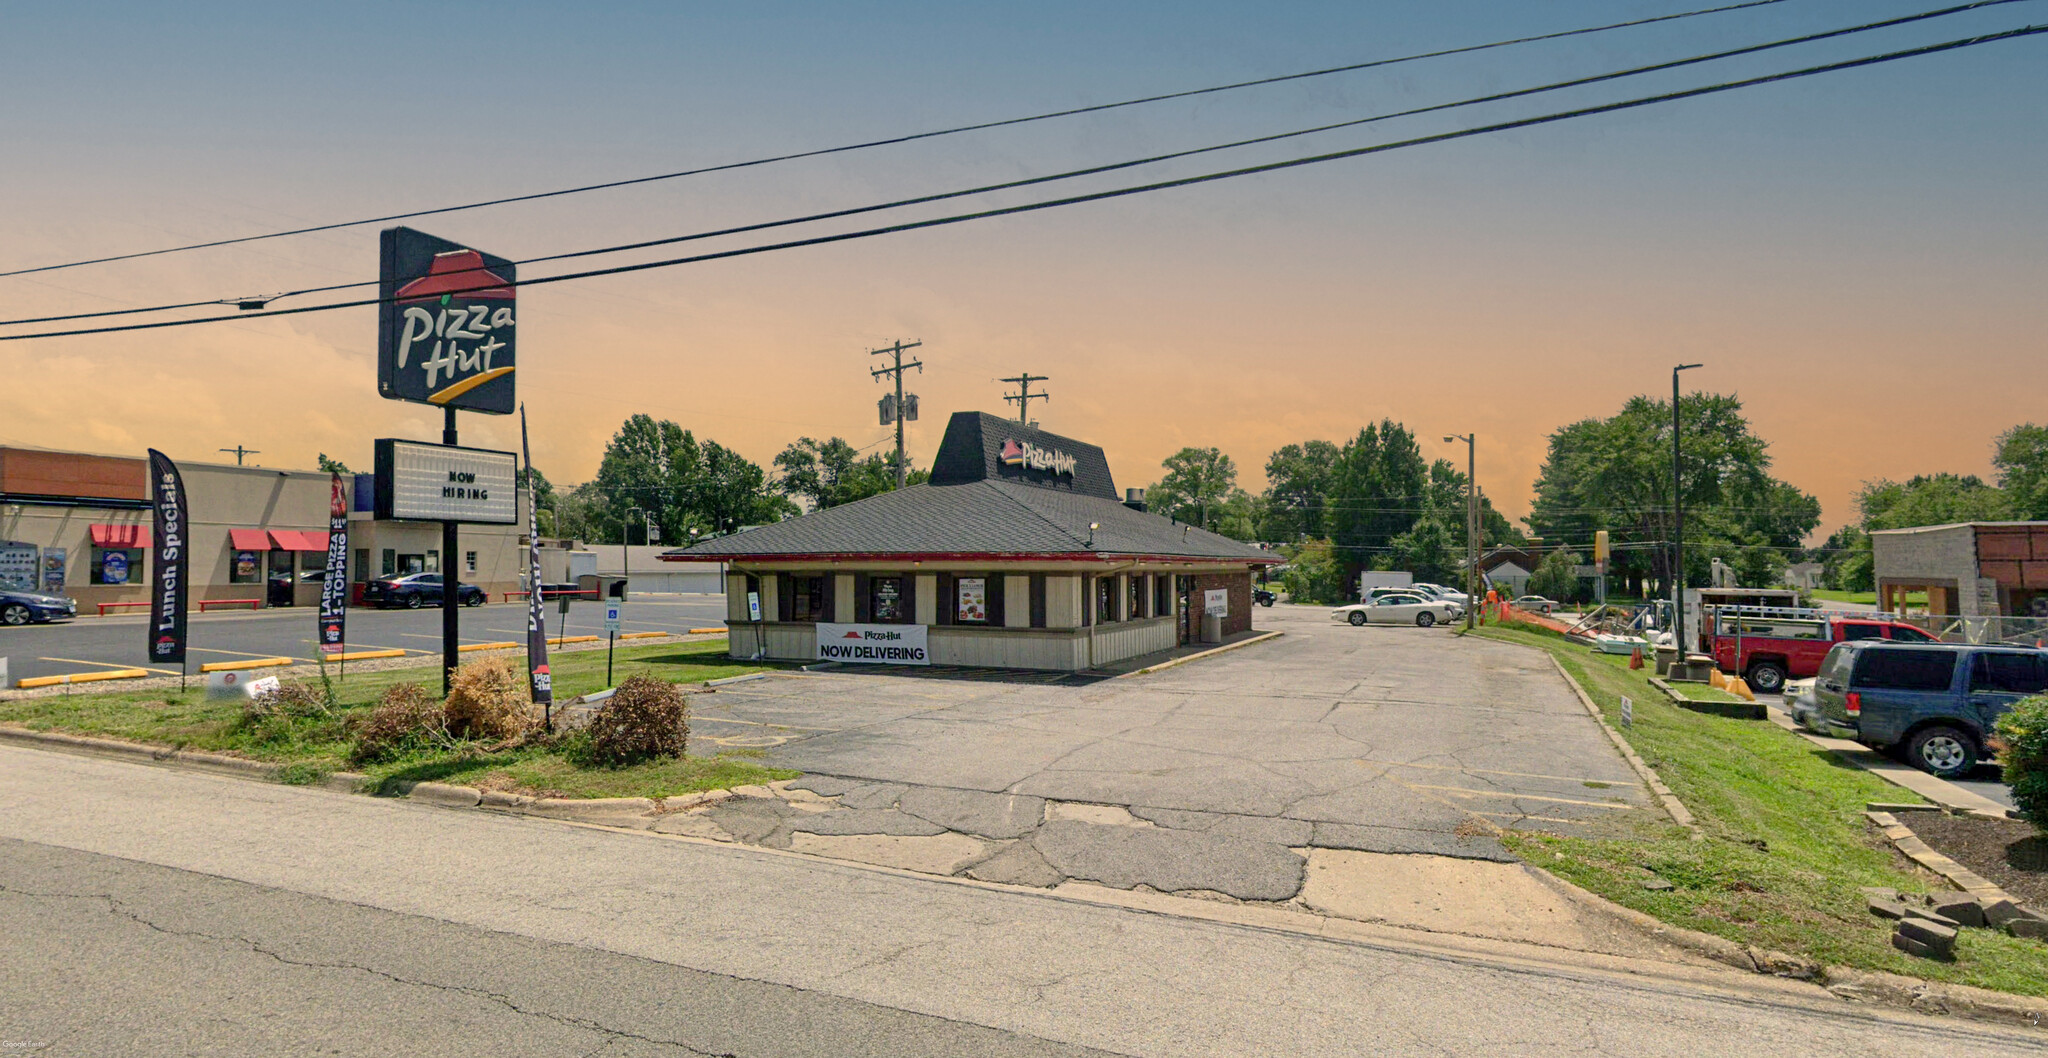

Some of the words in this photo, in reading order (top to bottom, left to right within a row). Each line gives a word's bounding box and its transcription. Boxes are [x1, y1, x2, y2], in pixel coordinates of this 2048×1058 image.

[398, 295, 515, 369] Pizza
[421, 336, 506, 388] Hut
[449, 471, 475, 483] NOW
[1021, 441, 1055, 471] Pizza
[1053, 448, 1077, 477] Hut
[161, 473, 182, 561] Specials
[443, 486, 488, 500] HIRING
[160, 566, 177, 631] Lunch
[320, 572, 334, 616] LARGE
[327, 533, 338, 571] PIZZA
[332, 533, 346, 615] 1-TOPPING
[820, 645, 852, 658] NOW
[854, 646, 925, 660] DELIVERING
[864, 631, 886, 640] Pizza
[885, 631, 901, 640] Hut
